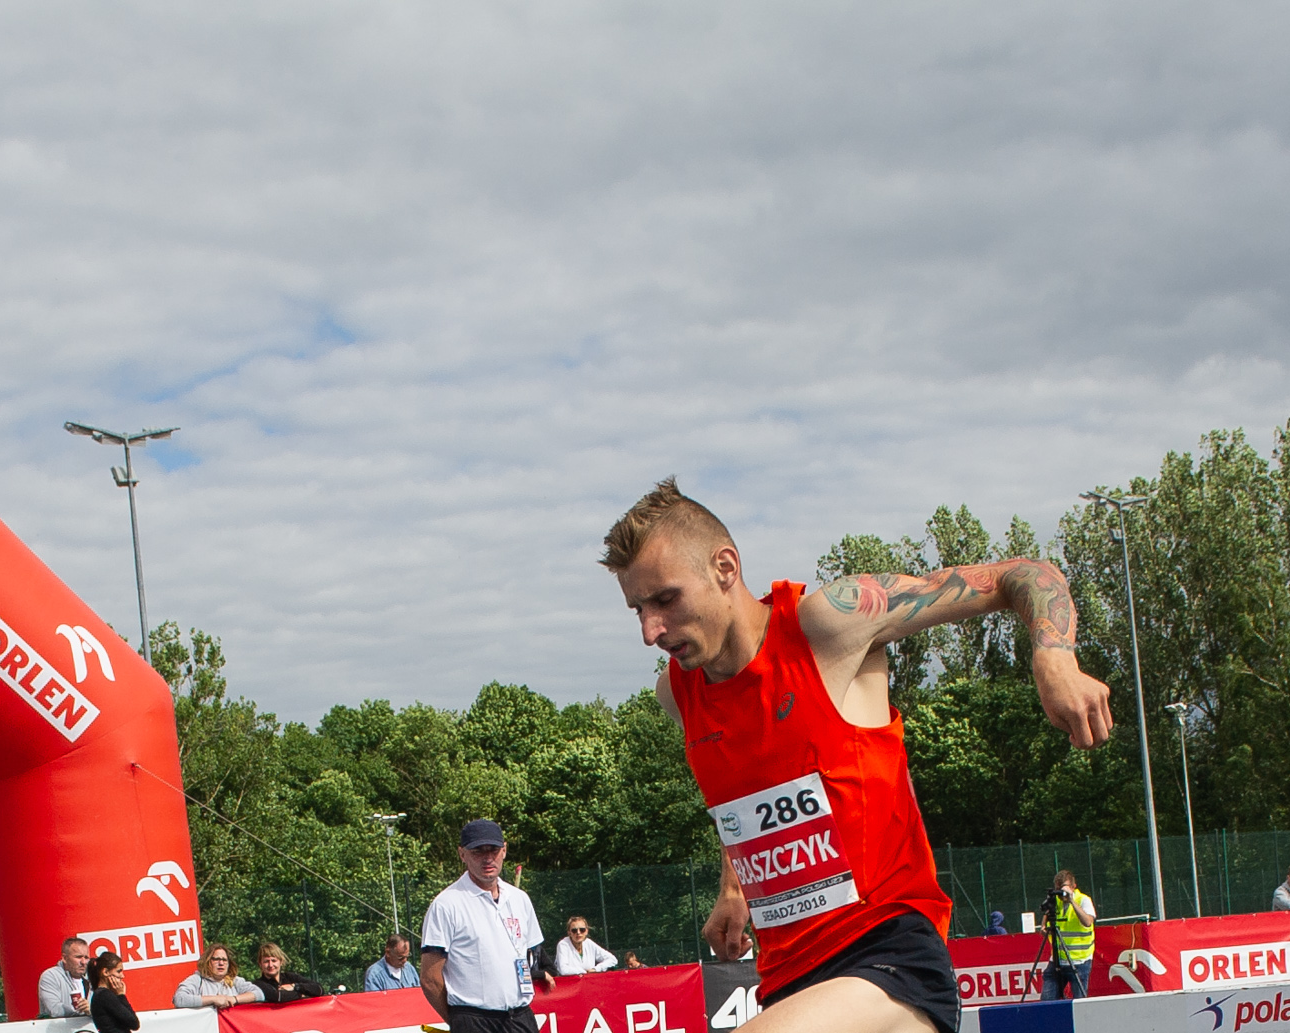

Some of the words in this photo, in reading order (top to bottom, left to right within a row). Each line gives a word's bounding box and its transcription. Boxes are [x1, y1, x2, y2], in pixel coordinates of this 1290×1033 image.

[755, 788, 821, 832] 286
[732, 829, 840, 886] BŁASZCZYK
[797, 895, 827, 913] 2018
[88, 927, 196, 963] ORLEN
[1188, 948, 1288, 983] ORLEN
[956, 968, 1044, 1000] ORLEN
